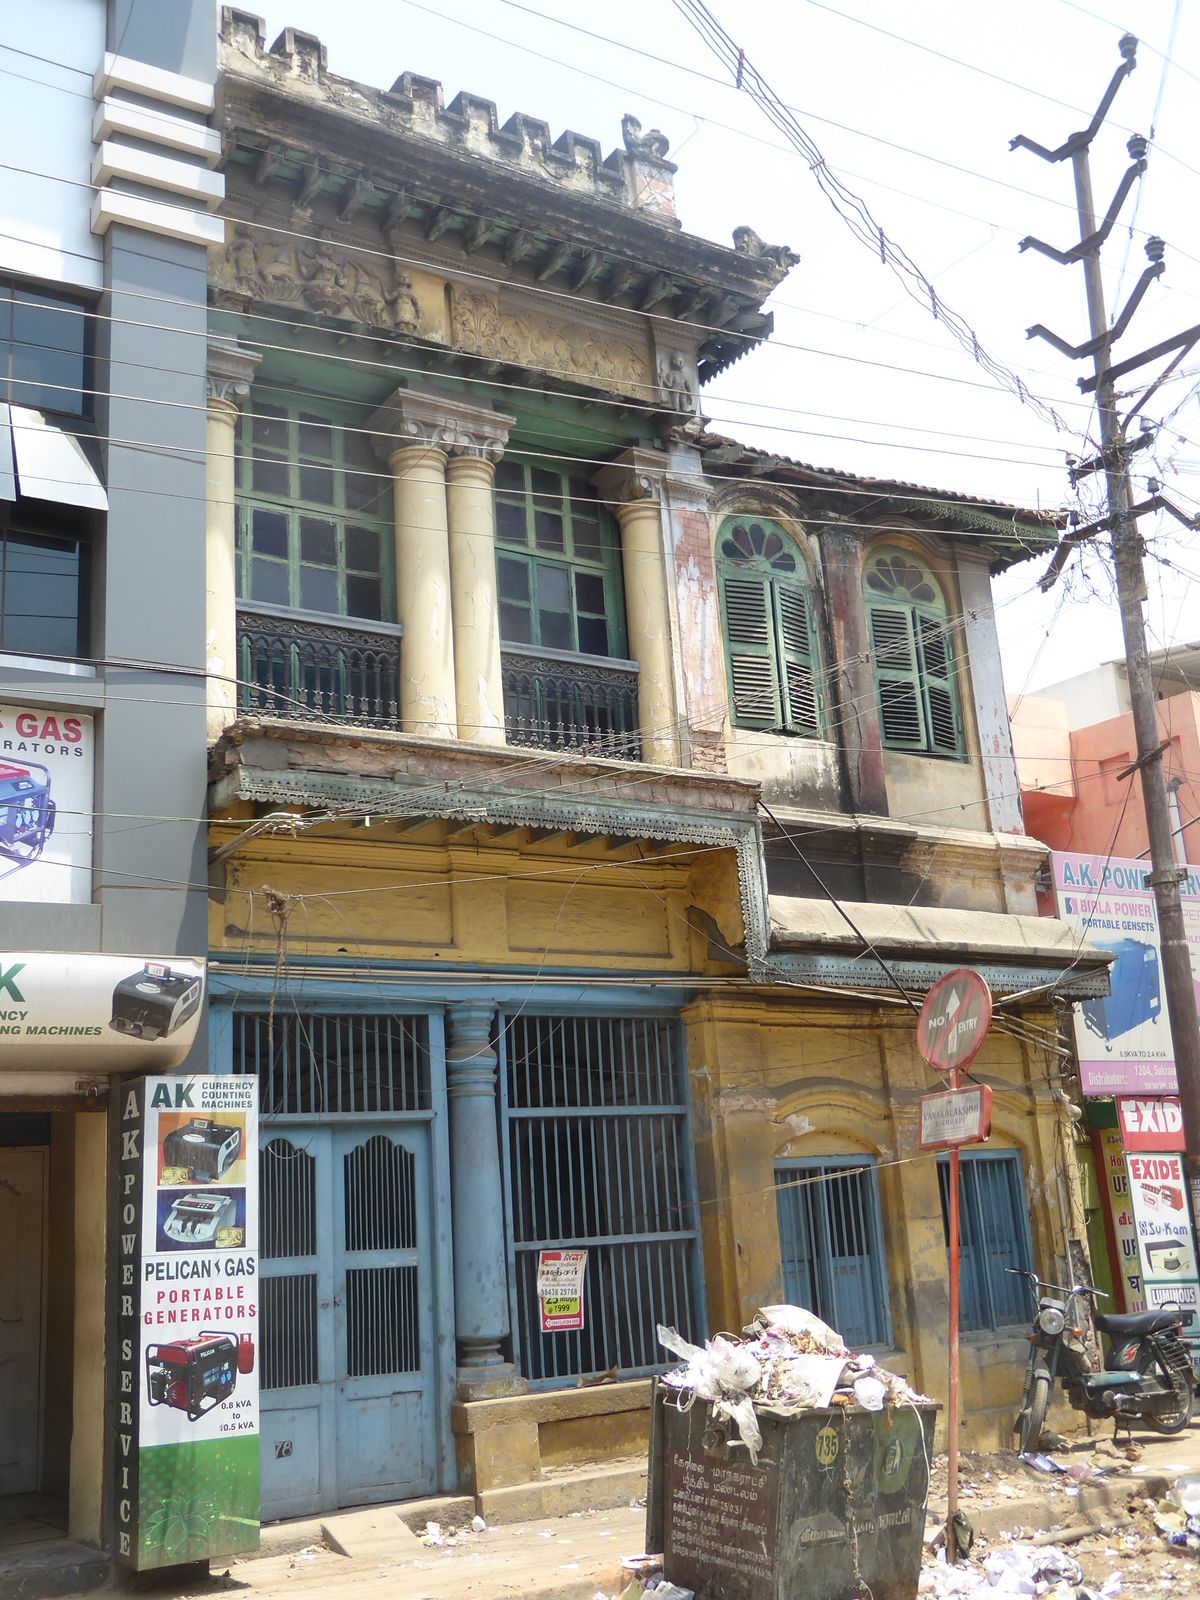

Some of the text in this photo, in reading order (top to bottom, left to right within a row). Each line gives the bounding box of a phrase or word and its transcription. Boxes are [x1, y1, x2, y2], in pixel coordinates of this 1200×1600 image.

[16, 713, 82, 743] GAS
[4, 740, 83, 757] RATORS
[1064, 862, 1097, 887] A.K.
[1081, 899, 1152, 918] BIRLA POWER
[1082, 918, 1155, 932] PORTABLE GENSETS
[26, 1026, 102, 1035] MACHINES
[929, 1016, 978, 1033] NO ENTRY
[202, 1082, 254, 1090] CURRENCY
[151, 1083, 195, 1108] AK
[202, 1091, 251, 1099] COUNTING
[202, 1100, 253, 1109] MACHINES
[1121, 1099, 1182, 1133] EXID
[1130, 1159, 1181, 1179] EXIDE
[1113, 1176, 1127, 1193] UP
[1149, 1221, 1187, 1235] Su-Kam
[121, 1174, 136, 1316] POWER
[564, 1253, 583, 1261] ACT
[145, 1257, 255, 1281] PELICAN GAS
[157, 1286, 244, 1304] PORTABLE
[1152, 1289, 1196, 1304] LUMINOUS
[144, 1304, 256, 1325] GENERATORS
[221, 1402, 234, 1410] 0.8
[219, 1423, 236, 1432] 10.5
[119, 1339, 133, 1557] SERVICE
[818, 1434, 837, 1457] 735
